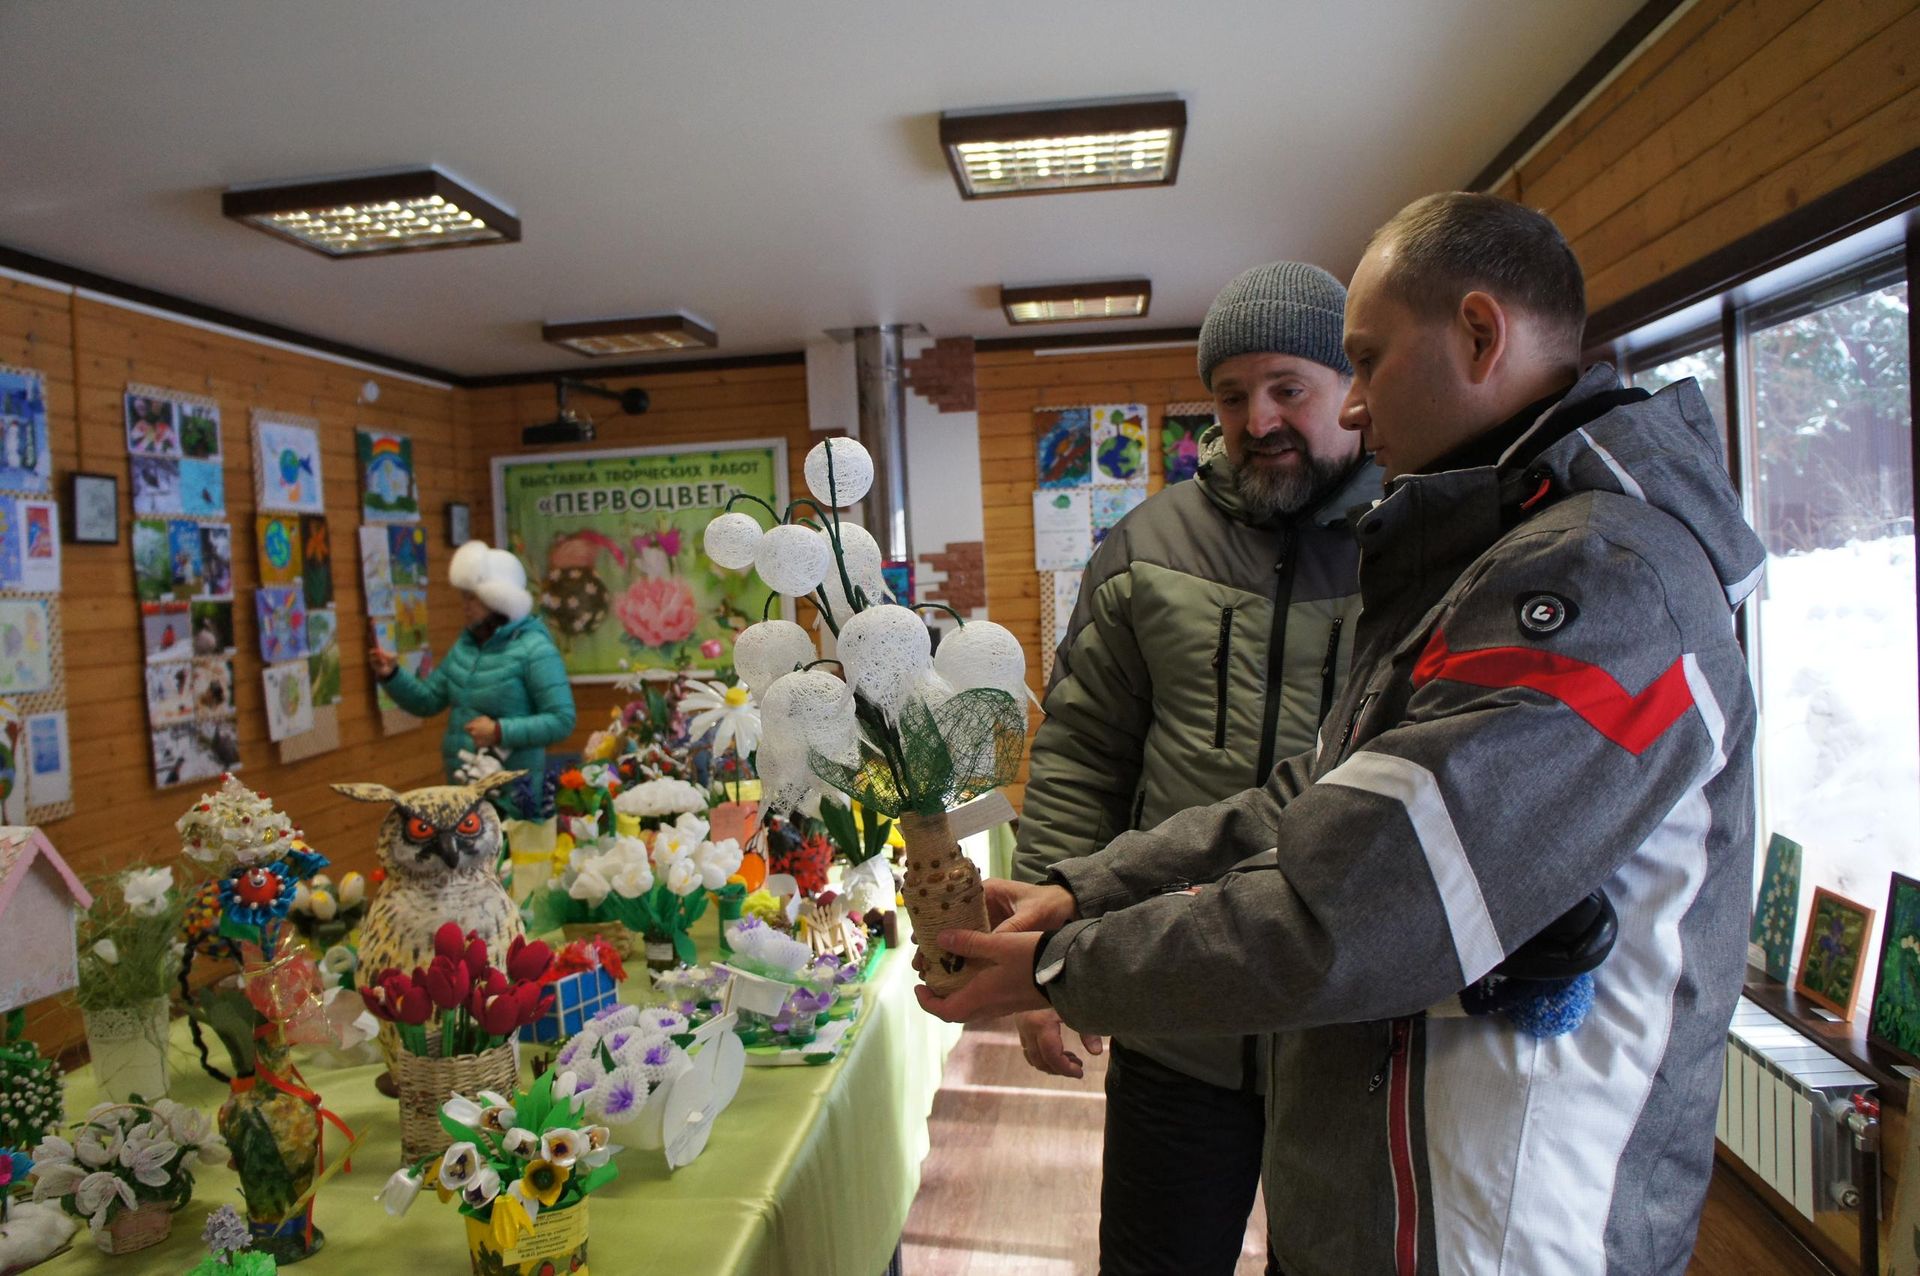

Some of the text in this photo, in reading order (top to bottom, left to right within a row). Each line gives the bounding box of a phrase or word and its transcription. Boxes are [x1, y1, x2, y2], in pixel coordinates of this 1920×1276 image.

[520, 462, 758, 488] ВЫСТАВКА ТВОРЧЕСКИХ РАБОТ
